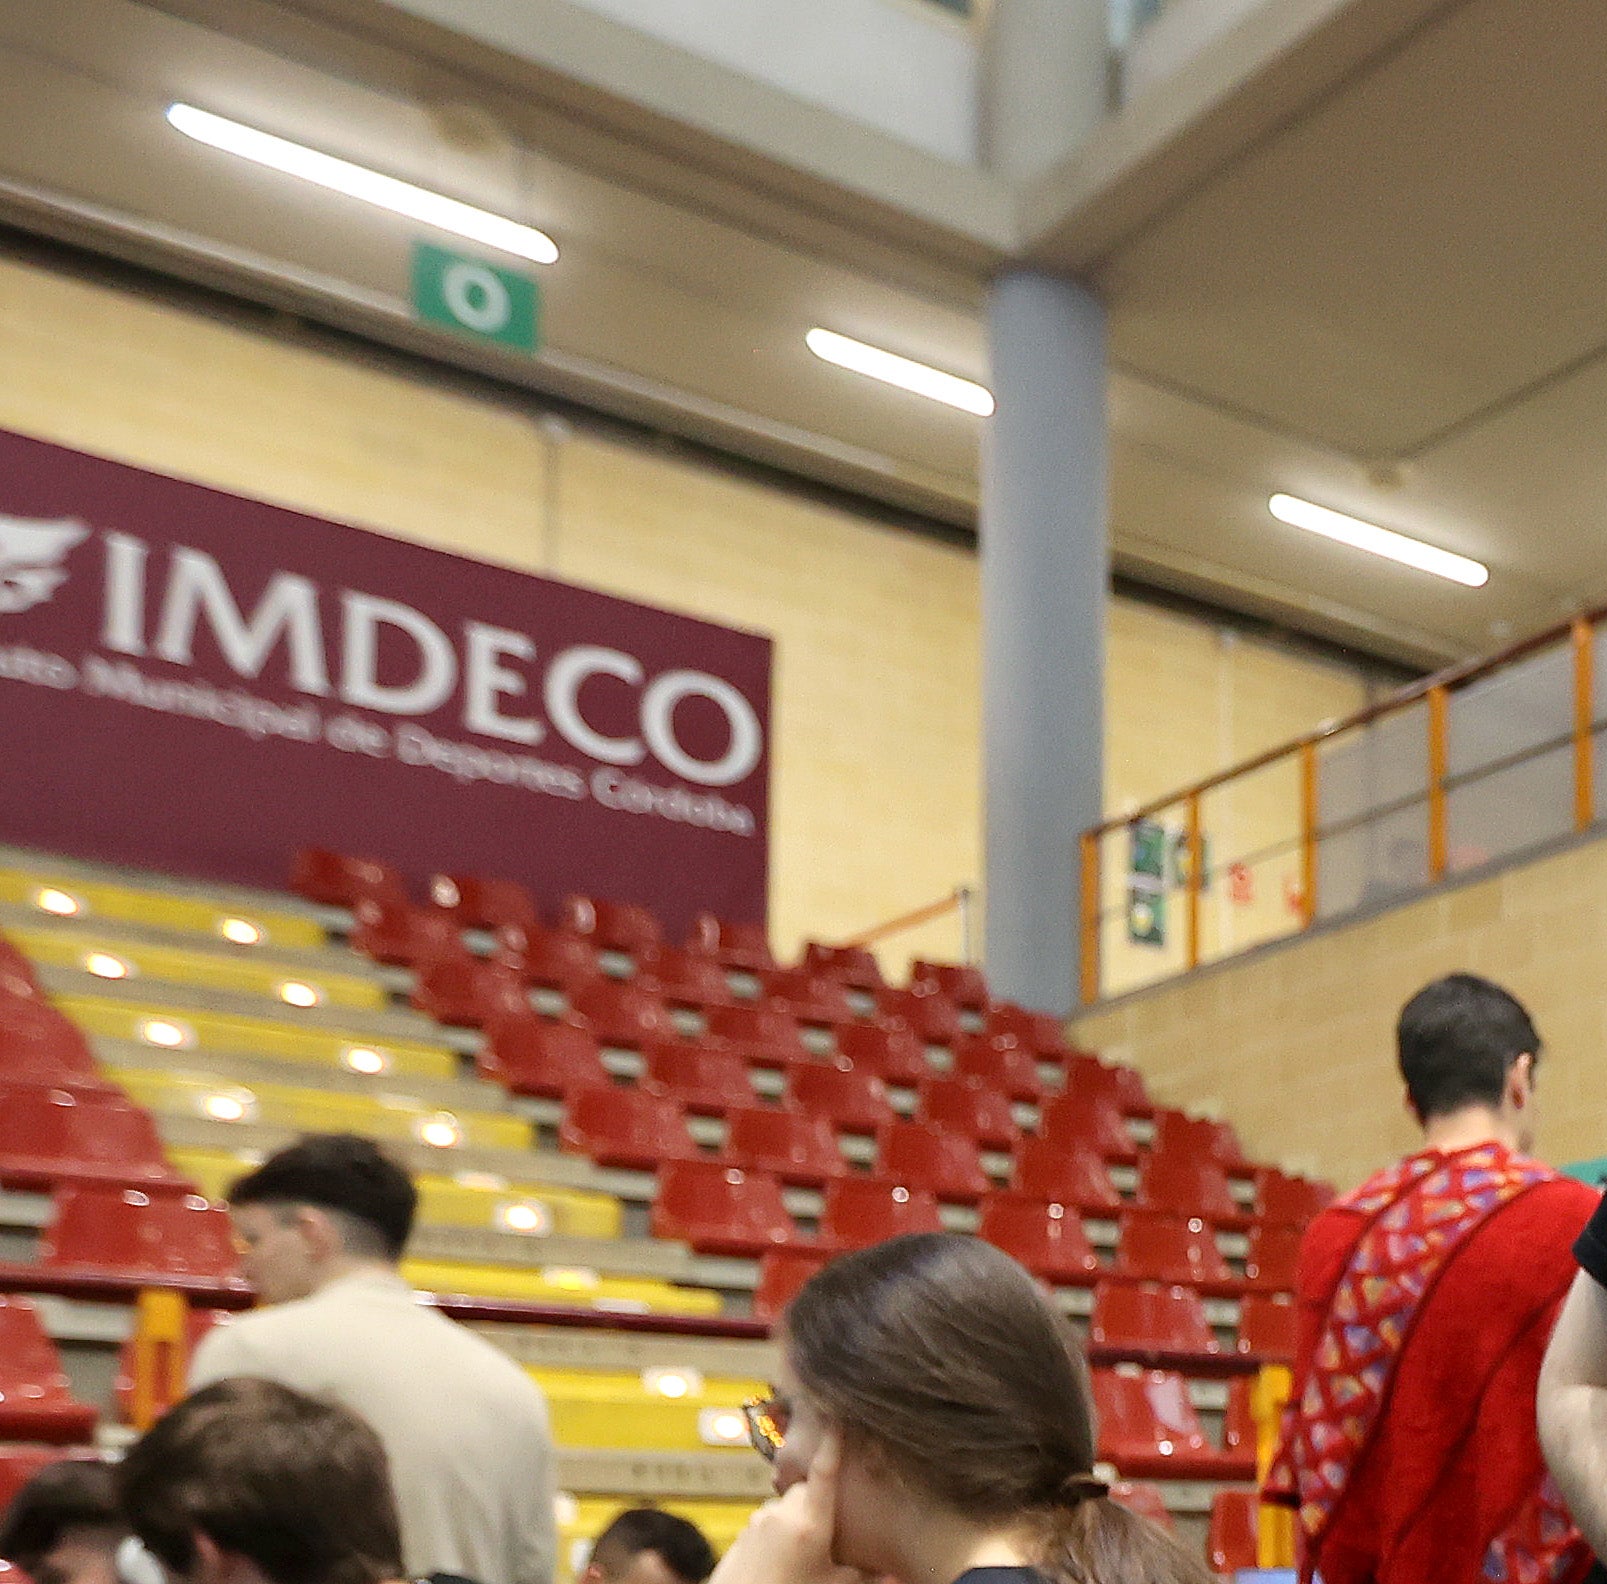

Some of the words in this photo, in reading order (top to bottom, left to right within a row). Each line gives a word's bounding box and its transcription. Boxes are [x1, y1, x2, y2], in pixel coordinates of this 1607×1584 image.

[443, 263, 511, 333] O
[80, 653, 323, 743] Municipal
[324, 711, 392, 759] de
[393, 723, 588, 801] Deportes
[100, 530, 763, 788] IMDECO
